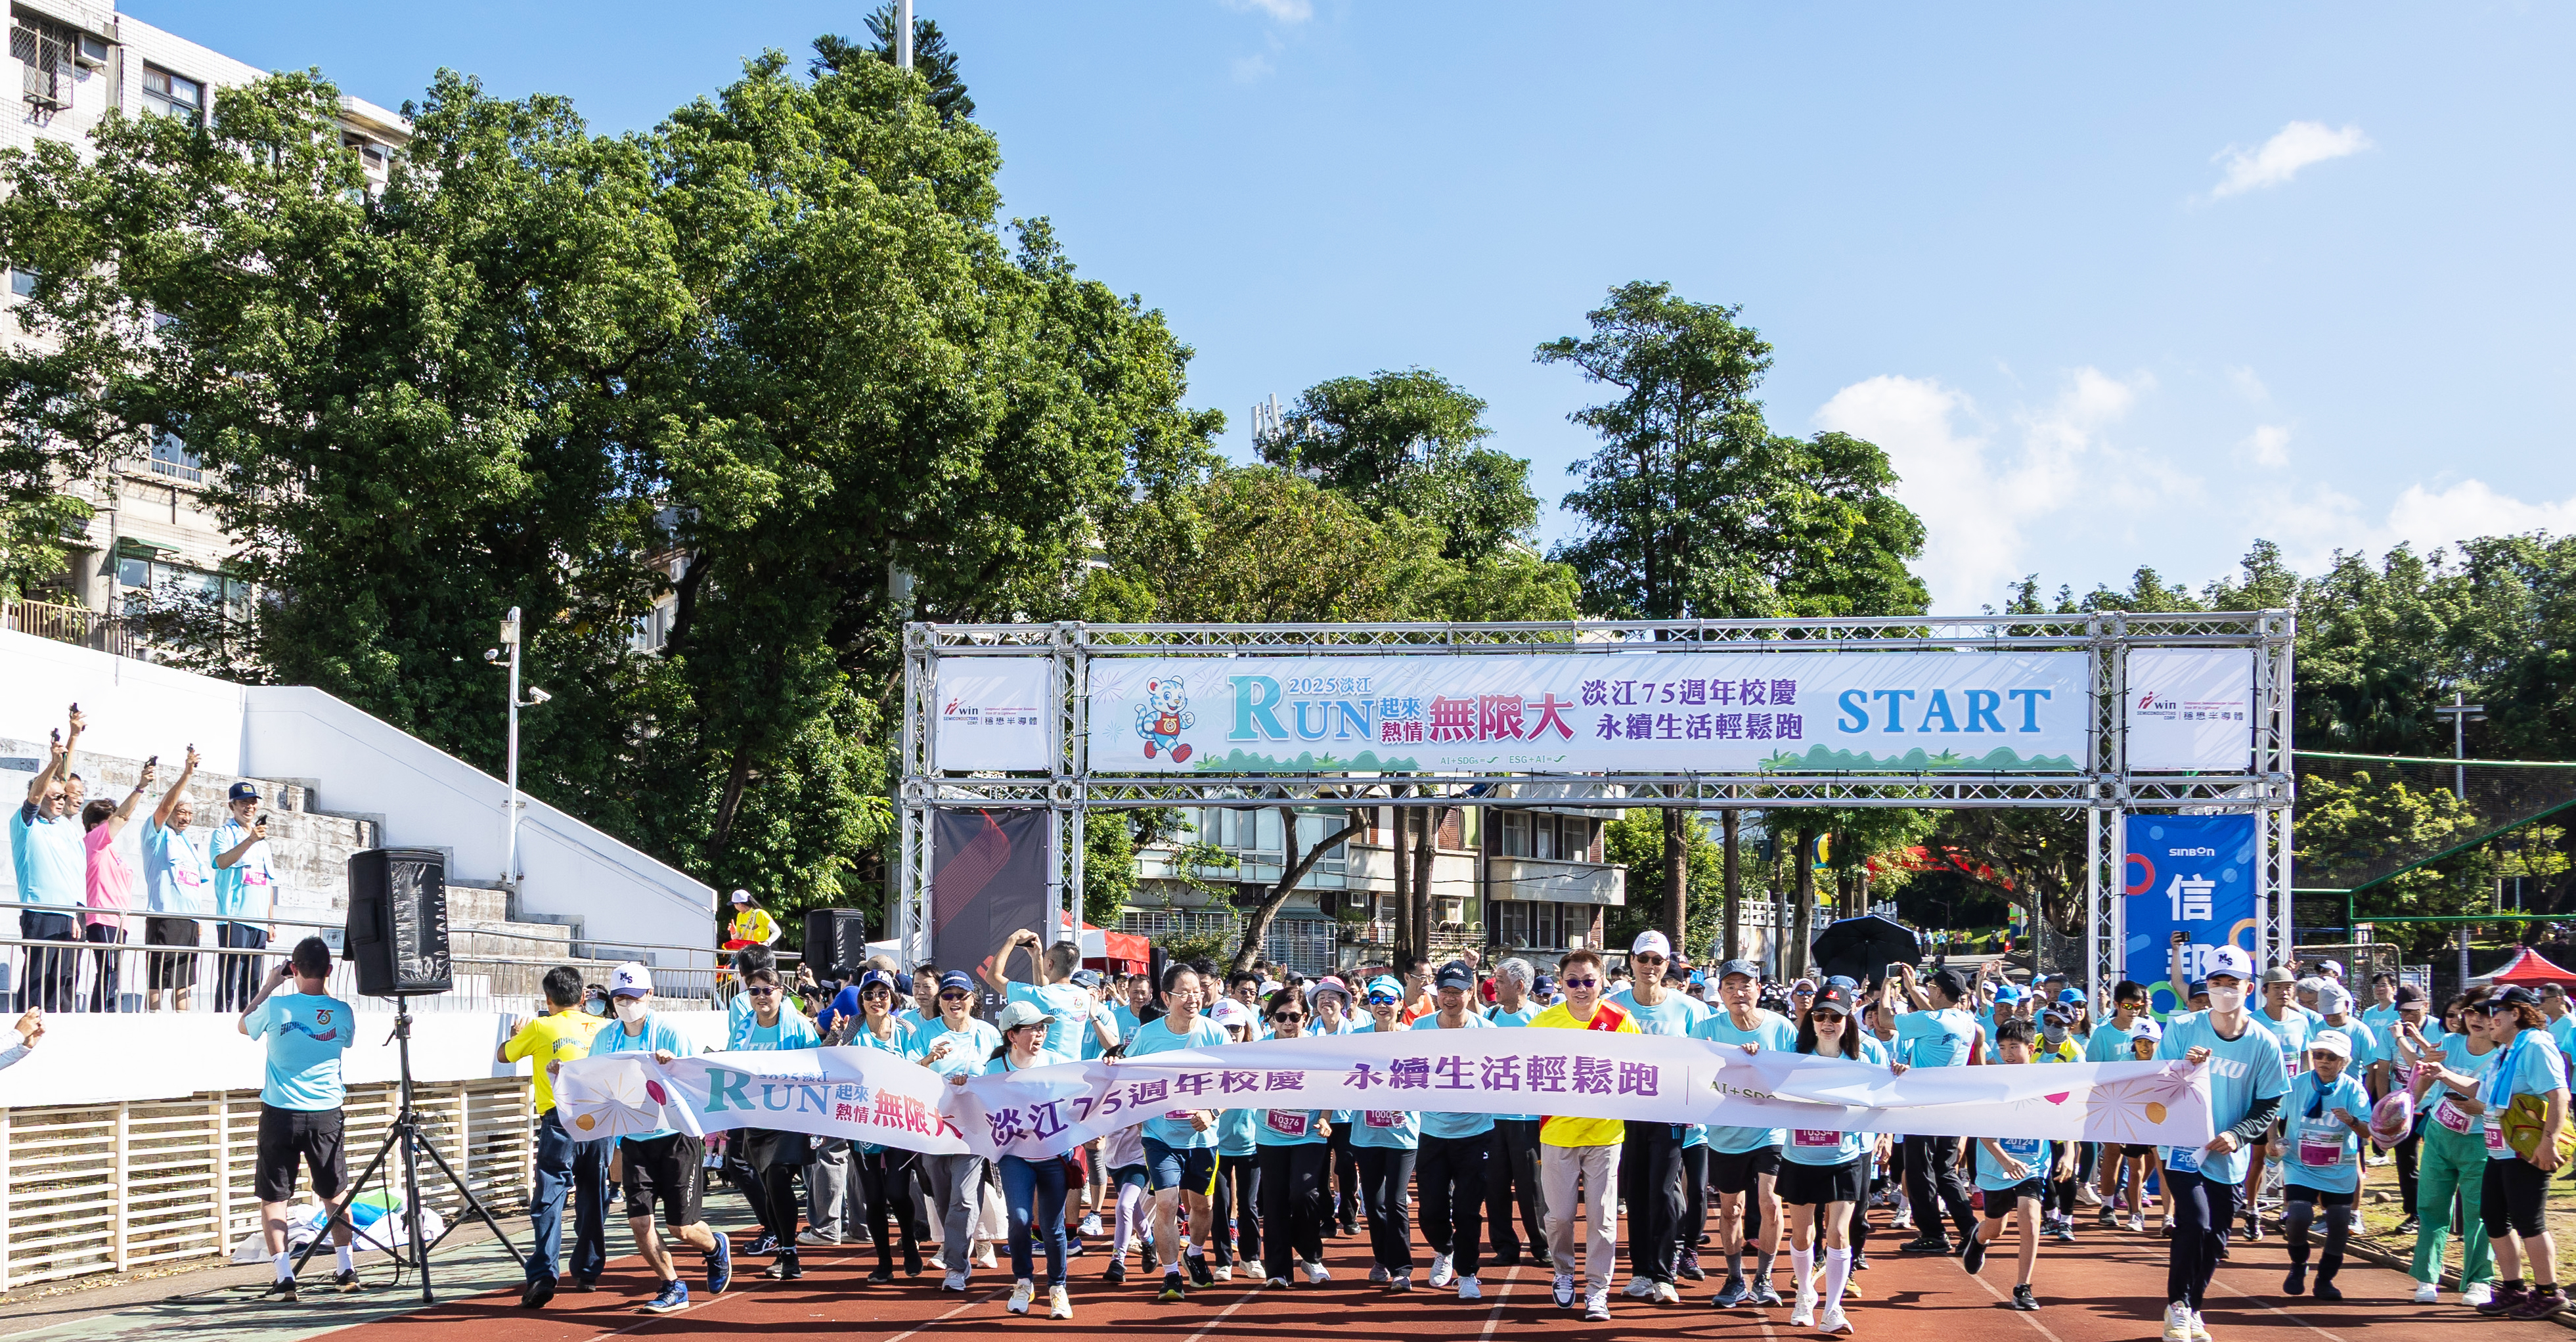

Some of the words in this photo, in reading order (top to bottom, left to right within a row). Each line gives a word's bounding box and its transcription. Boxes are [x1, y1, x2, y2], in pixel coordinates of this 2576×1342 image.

[1289, 677, 1371, 694] 2025淡江
[1582, 679, 1797, 706] 淡江75週年校慶
[959, 706, 978, 715] win
[1229, 675, 1374, 740] RUN
[1380, 697, 1421, 718] 起來
[1428, 694, 1574, 742] 無限大
[1838, 689, 2051, 734] START
[1381, 722, 1423, 743] 熱情
[1596, 713, 1803, 740] 永續生活輕鬆跑
[1636, 1019, 1672, 1035] KU
[703, 1067, 832, 1115] RUN
[835, 1084, 869, 1103] 起來
[984, 1070, 1306, 1148] 淡江75週年校慶
[1343, 1055, 1659, 1096] 永續生活輕鬆跑
[835, 1103, 870, 1124] 熱情
[872, 1087, 964, 1140] 無限大
[1274, 1114, 1299, 1127] 10376
